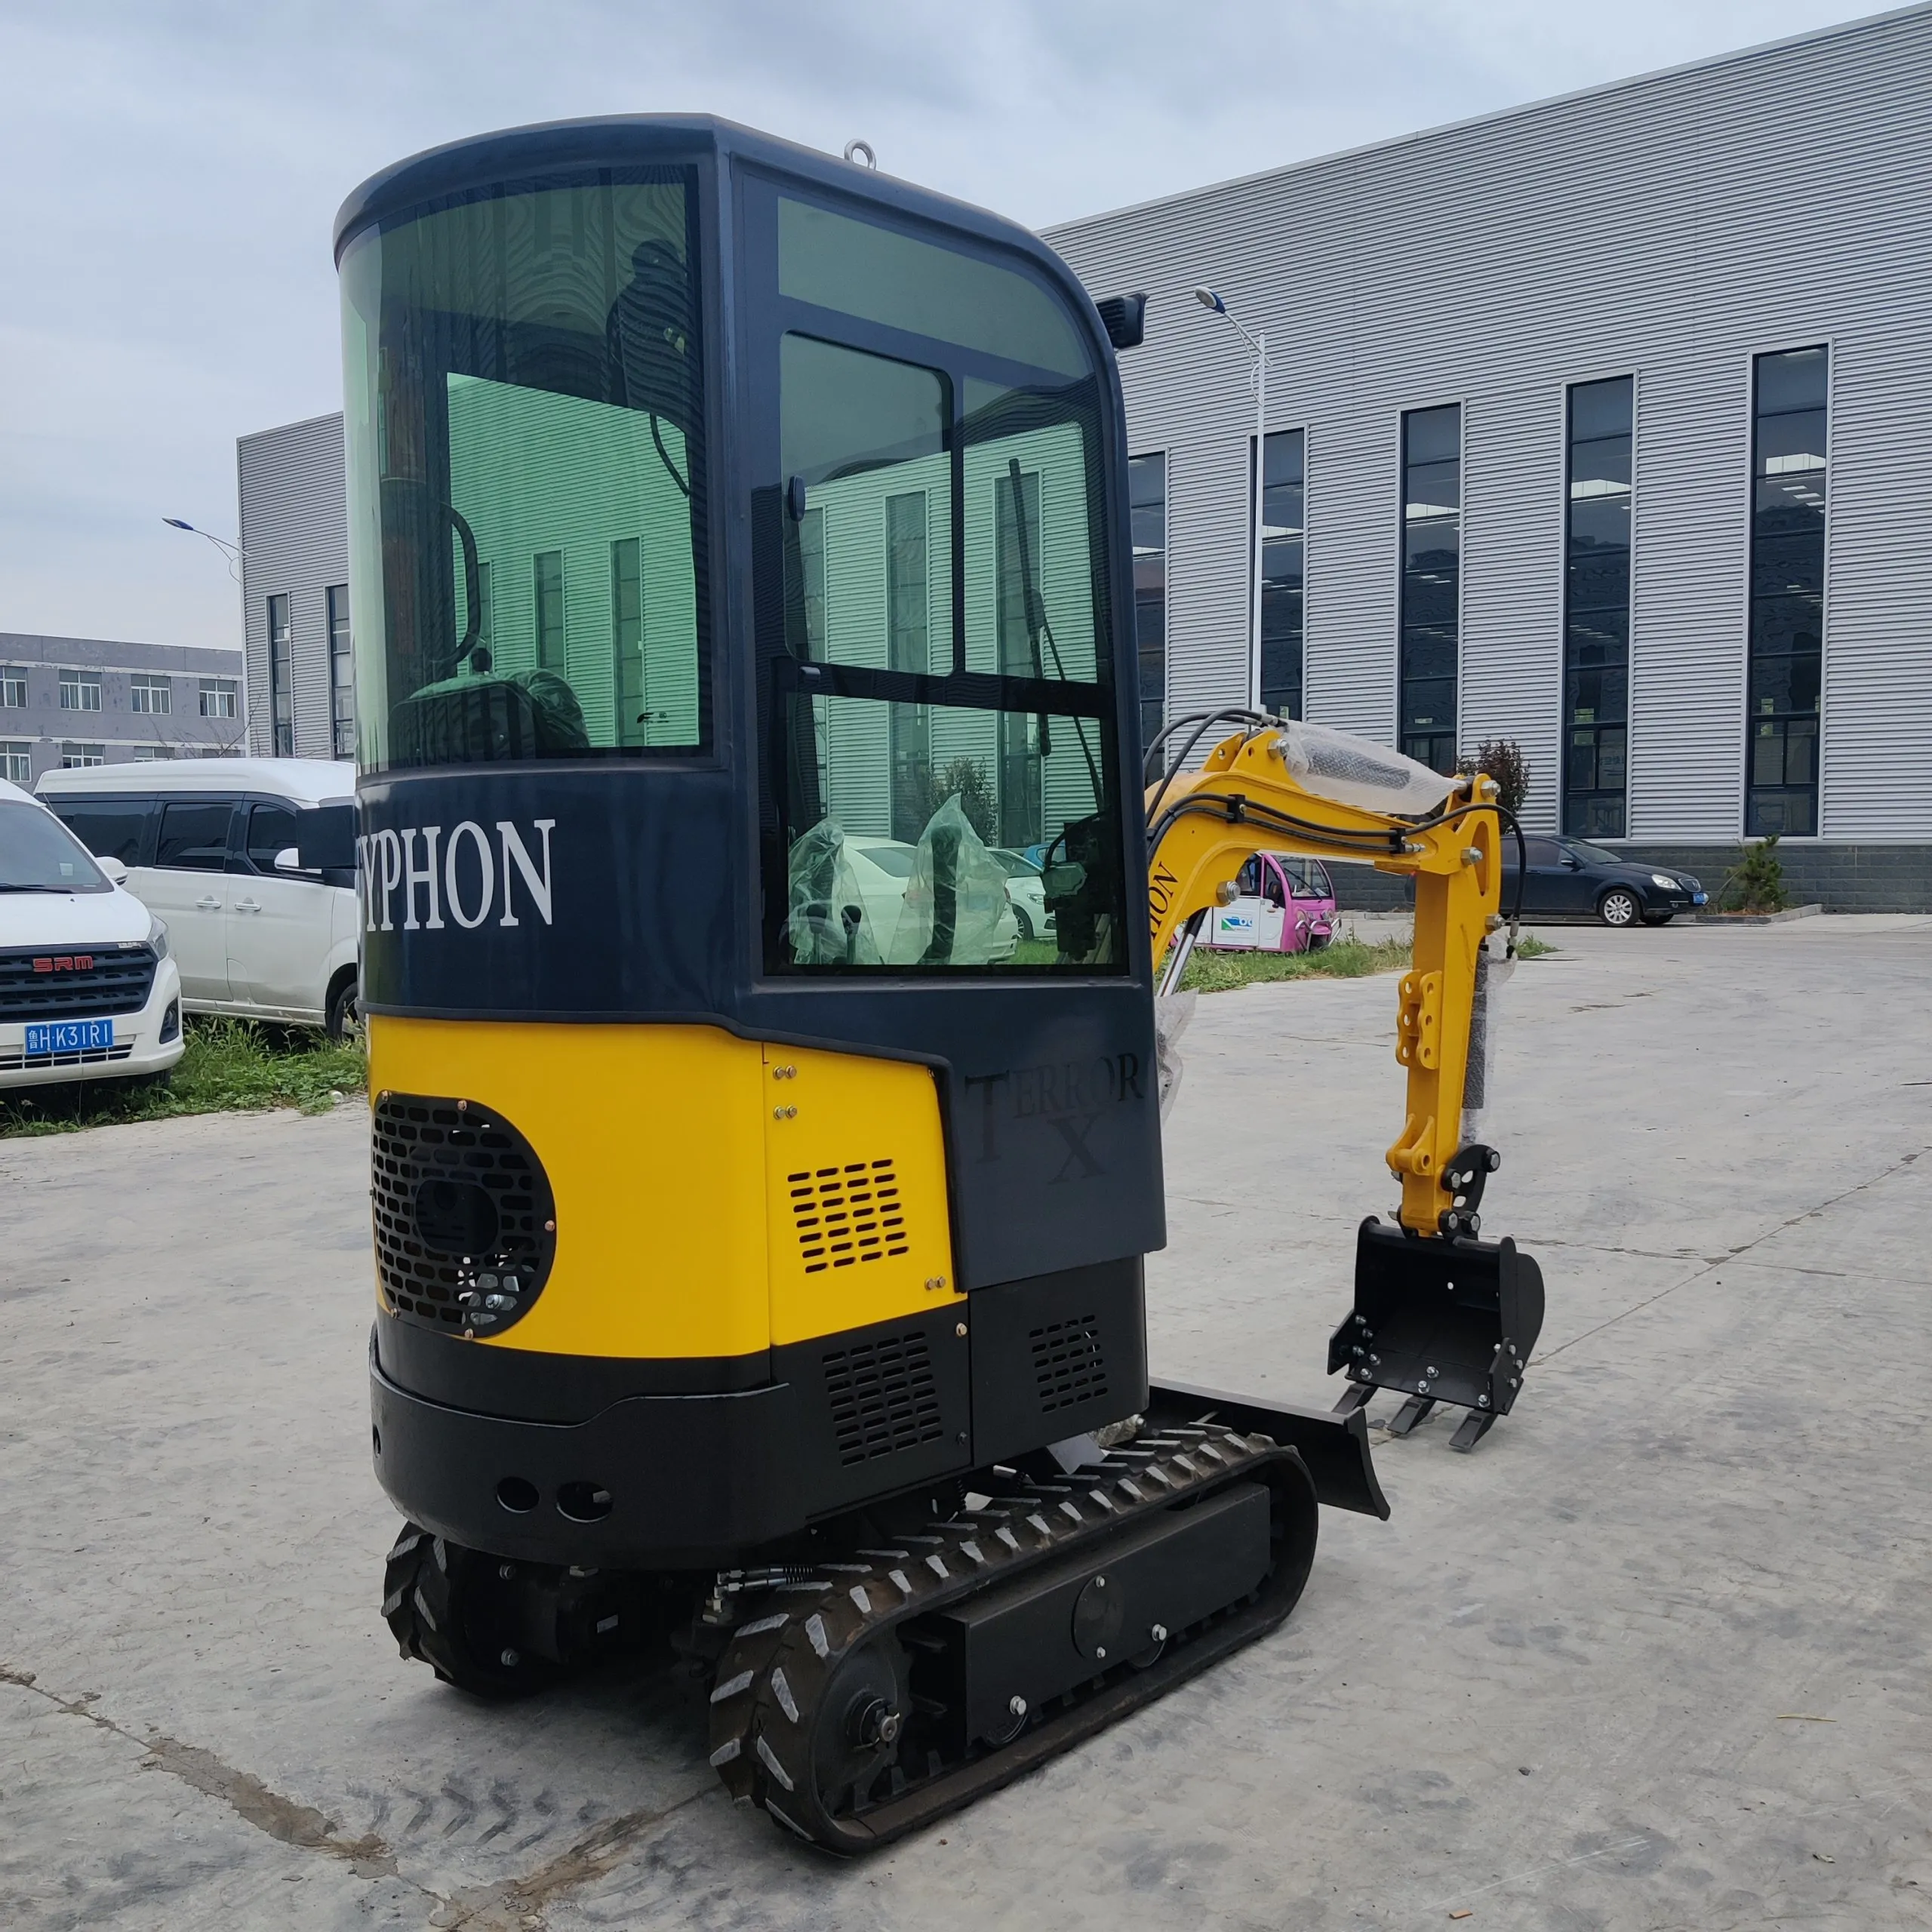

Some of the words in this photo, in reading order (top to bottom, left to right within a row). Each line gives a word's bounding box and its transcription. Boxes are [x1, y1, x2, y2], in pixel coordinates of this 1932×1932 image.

[33, 955, 94, 973] SRM
[964, 1052, 1145, 1163] TERROR
[1046, 1111, 1106, 1184] X
